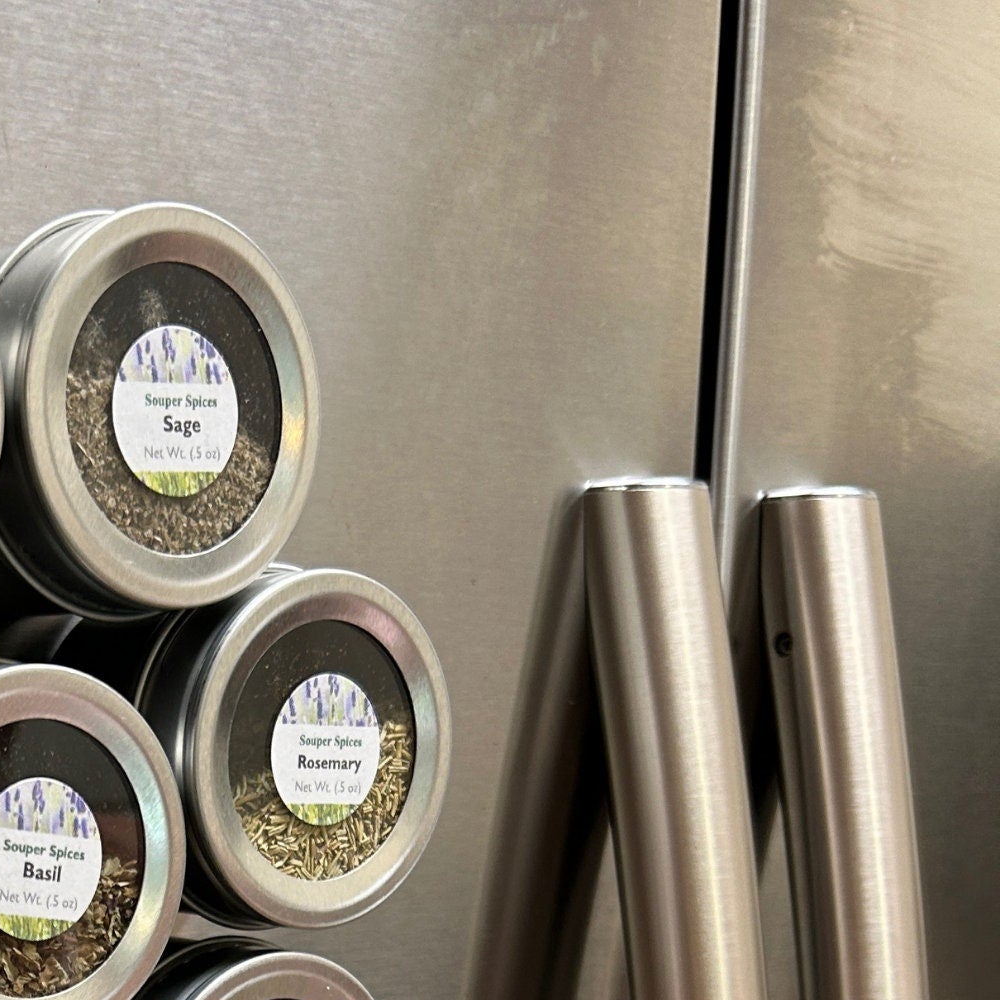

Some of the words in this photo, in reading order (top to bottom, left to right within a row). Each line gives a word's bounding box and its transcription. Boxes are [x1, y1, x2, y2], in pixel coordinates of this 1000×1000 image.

[145, 393, 182, 409] Souper
[185, 394, 217, 410] Spices
[164, 415, 201, 438] Sage
[144, 446, 164, 458] Net
[205, 447, 221, 461] oz)
[300, 734, 332, 749] Souper
[334, 736, 362, 749] Spices
[298, 755, 362, 774] Rosemary
[295, 781, 312, 792] Net
[348, 782, 361, 795] oz)
[3, 839, 46, 857] Souper
[49, 845, 85, 862] Spices
[23, 862, 62, 882] Basil
[0, 889, 19, 903] Net
[62, 897, 78, 911] oz)
